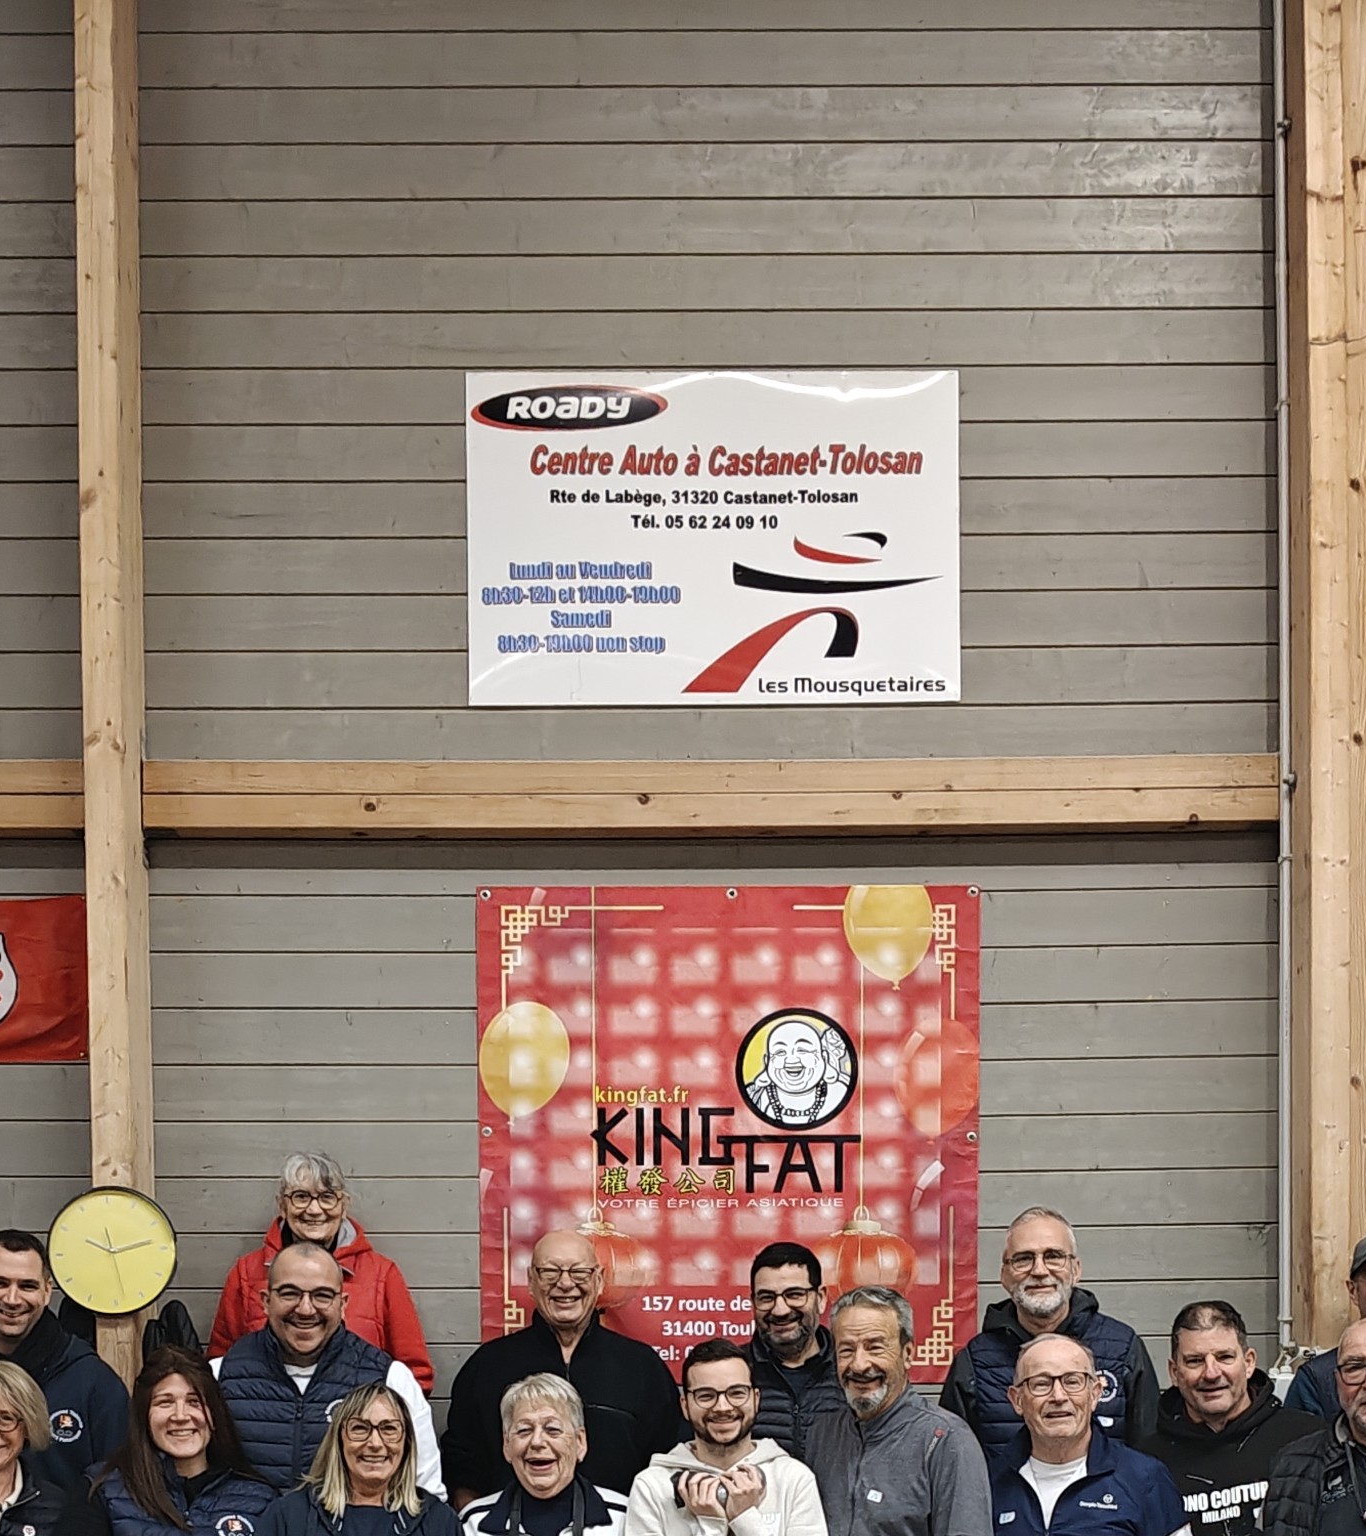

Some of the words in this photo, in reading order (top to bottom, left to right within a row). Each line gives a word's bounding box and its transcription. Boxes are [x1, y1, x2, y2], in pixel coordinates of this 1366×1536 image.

[530, 443, 614, 476] Centre
[618, 444, 678, 476] Auto
[684, 444, 701, 476] à
[708, 443, 924, 477] Castanet-Tolosan
[549, 489, 577, 503] Rte
[581, 489, 600, 503] de
[604, 489, 667, 507] Labège,
[671, 490, 719, 505] 31320
[723, 489, 859, 505] Castanet-Tolosan
[630, 514, 660, 529] Tél.
[664, 515, 684, 529] 05
[688, 515, 708, 529] 62
[712, 515, 731, 529] 24
[736, 515, 755, 530] 09
[759, 515, 778, 529] 10
[509, 561, 553, 580] Lundi
[555, 562, 577, 580] au
[578, 561, 653, 580] Vendredi
[558, 586, 576, 604] et
[550, 609, 612, 629] Samedi
[596, 635, 627, 652] non
[629, 634, 666, 655] stop
[758, 677, 789, 695] les
[793, 676, 946, 697] Mousquetaires
[595, 1085, 689, 1107] kingfat.fr
[590, 1107, 735, 1165] KING
[738, 1135, 862, 1193] FAT
[598, 1199, 659, 1209] VOTRE
[667, 1197, 738, 1208] ÉPICIER
[746, 1198, 844, 1208] ASIATIQUE
[642, 1296, 674, 1311] 157
[678, 1297, 725, 1311] route
[730, 1295, 752, 1311] de
[662, 1320, 716, 1336] 31400
[1202, 1505, 1241, 1524] MILANO
